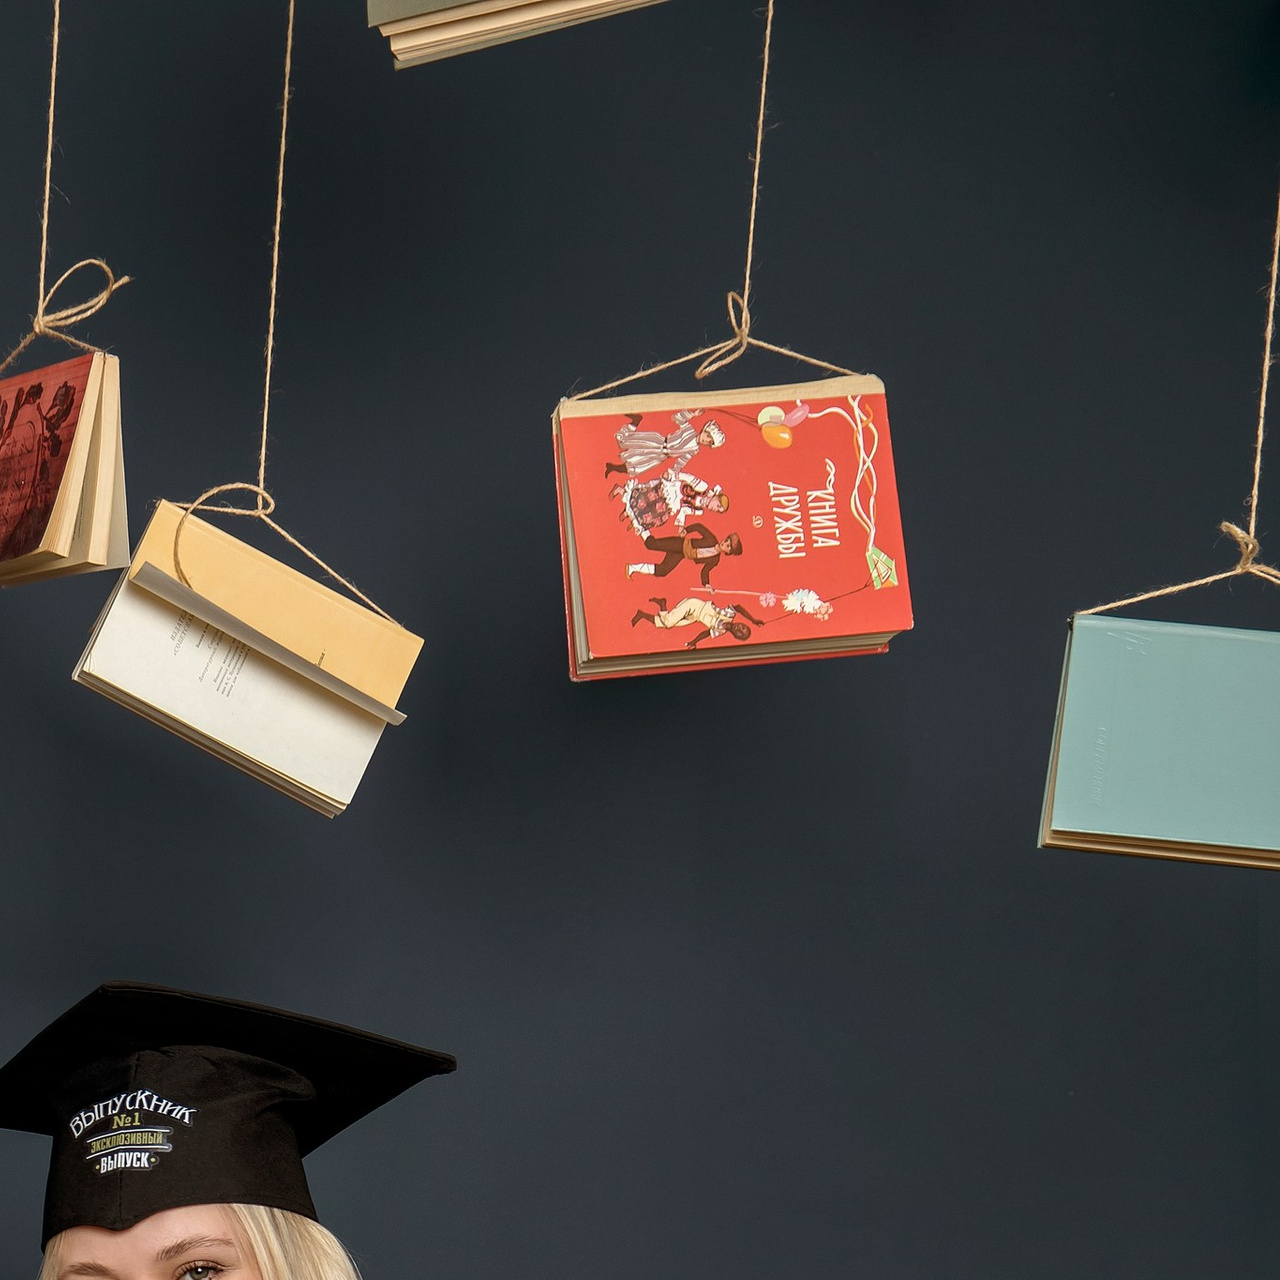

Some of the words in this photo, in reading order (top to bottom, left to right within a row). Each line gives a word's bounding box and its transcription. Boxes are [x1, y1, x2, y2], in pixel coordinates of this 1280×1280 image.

[767, 481, 807, 559] ДРУЖБЫ
[806, 458, 841, 549] КНИГА
[70, 1089, 197, 1139] ВЫПУСКНИК
[112, 1112, 141, 1129] №1
[90, 1131, 163, 1153] ЭКСКЛЮЗИВНЫЙ
[100, 1151, 150, 1174] ВЫПУСК
